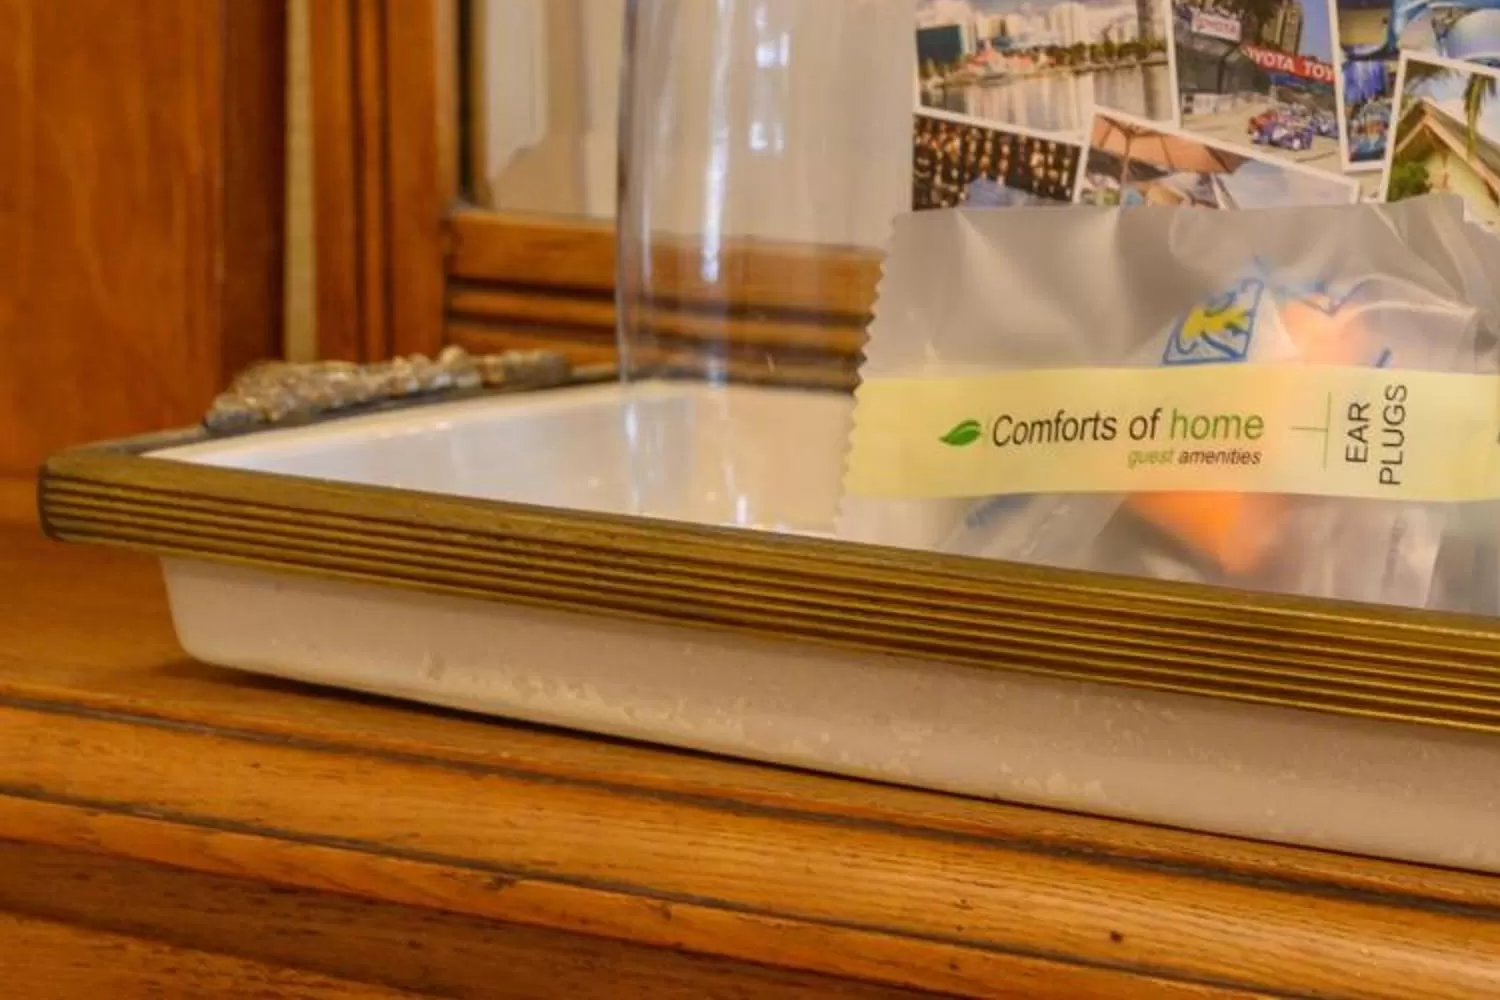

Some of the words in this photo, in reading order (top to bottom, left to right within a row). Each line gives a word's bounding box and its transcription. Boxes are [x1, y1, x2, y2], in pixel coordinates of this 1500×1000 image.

[992, 409, 1117, 447] Comforts
[1128, 407, 1162, 441] of
[1170, 408, 1265, 441] home
[1345, 402, 1371, 463] EAR
[1379, 384, 1408, 485] PLUGS
[1127, 449, 1174, 469] guest
[1177, 448, 1262, 465] amenities
